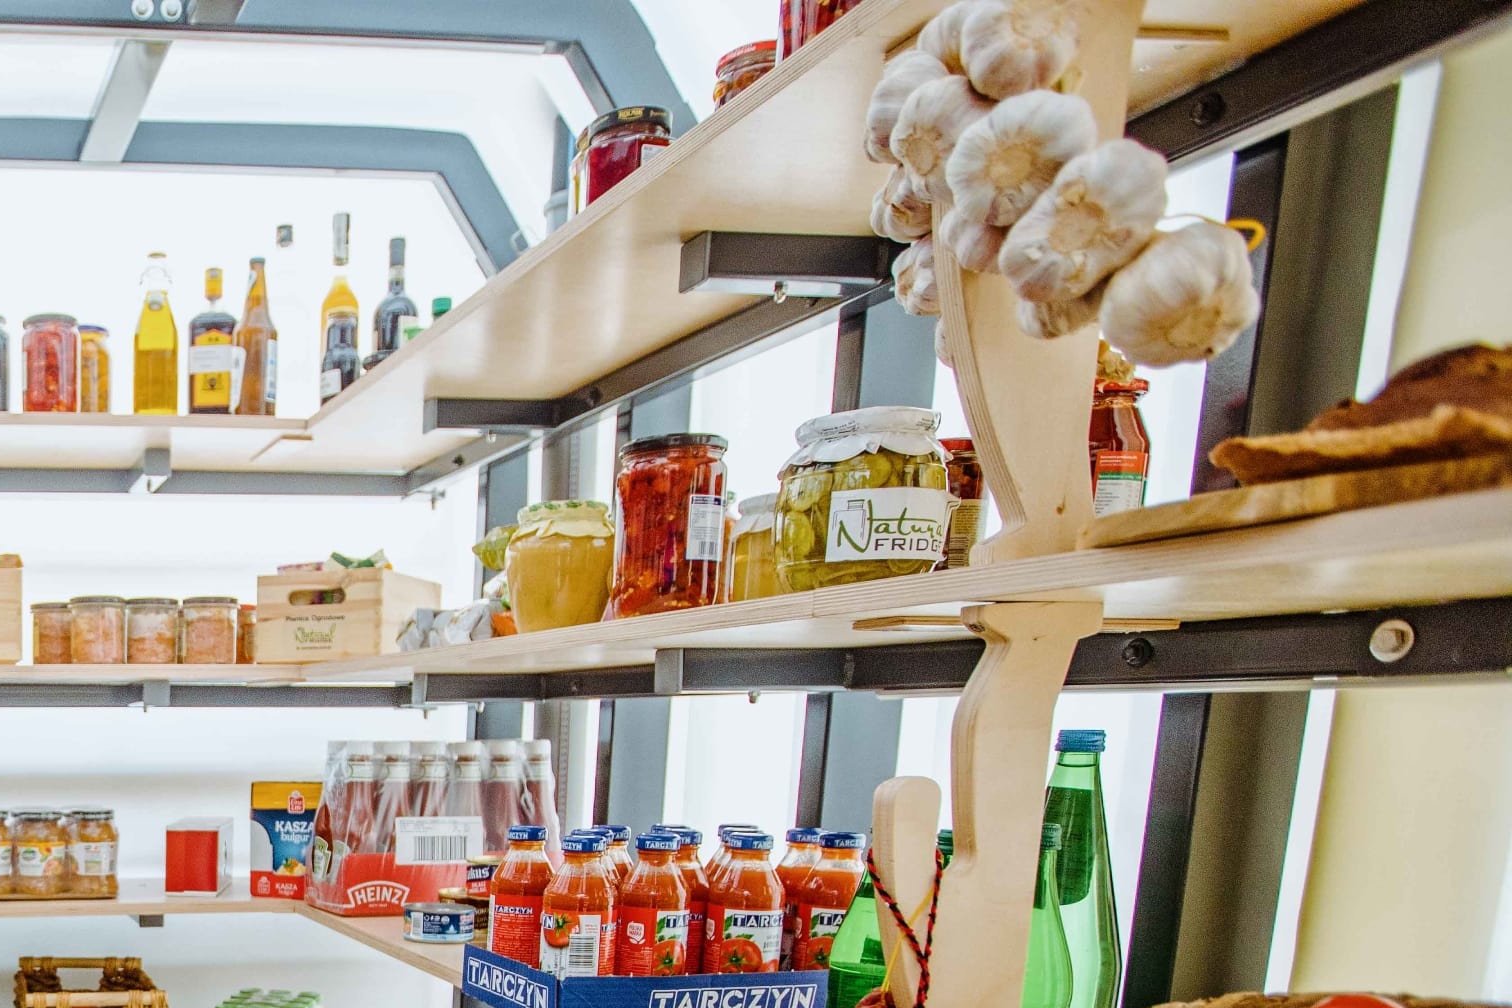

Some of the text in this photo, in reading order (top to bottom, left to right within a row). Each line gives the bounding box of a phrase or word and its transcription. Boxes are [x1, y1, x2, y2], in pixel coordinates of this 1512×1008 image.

[274, 820, 315, 833] KASZA
[280, 831, 310, 844] bulgur
[355, 887, 404, 904] HEINZ
[495, 906, 533, 914] TARCZYN
